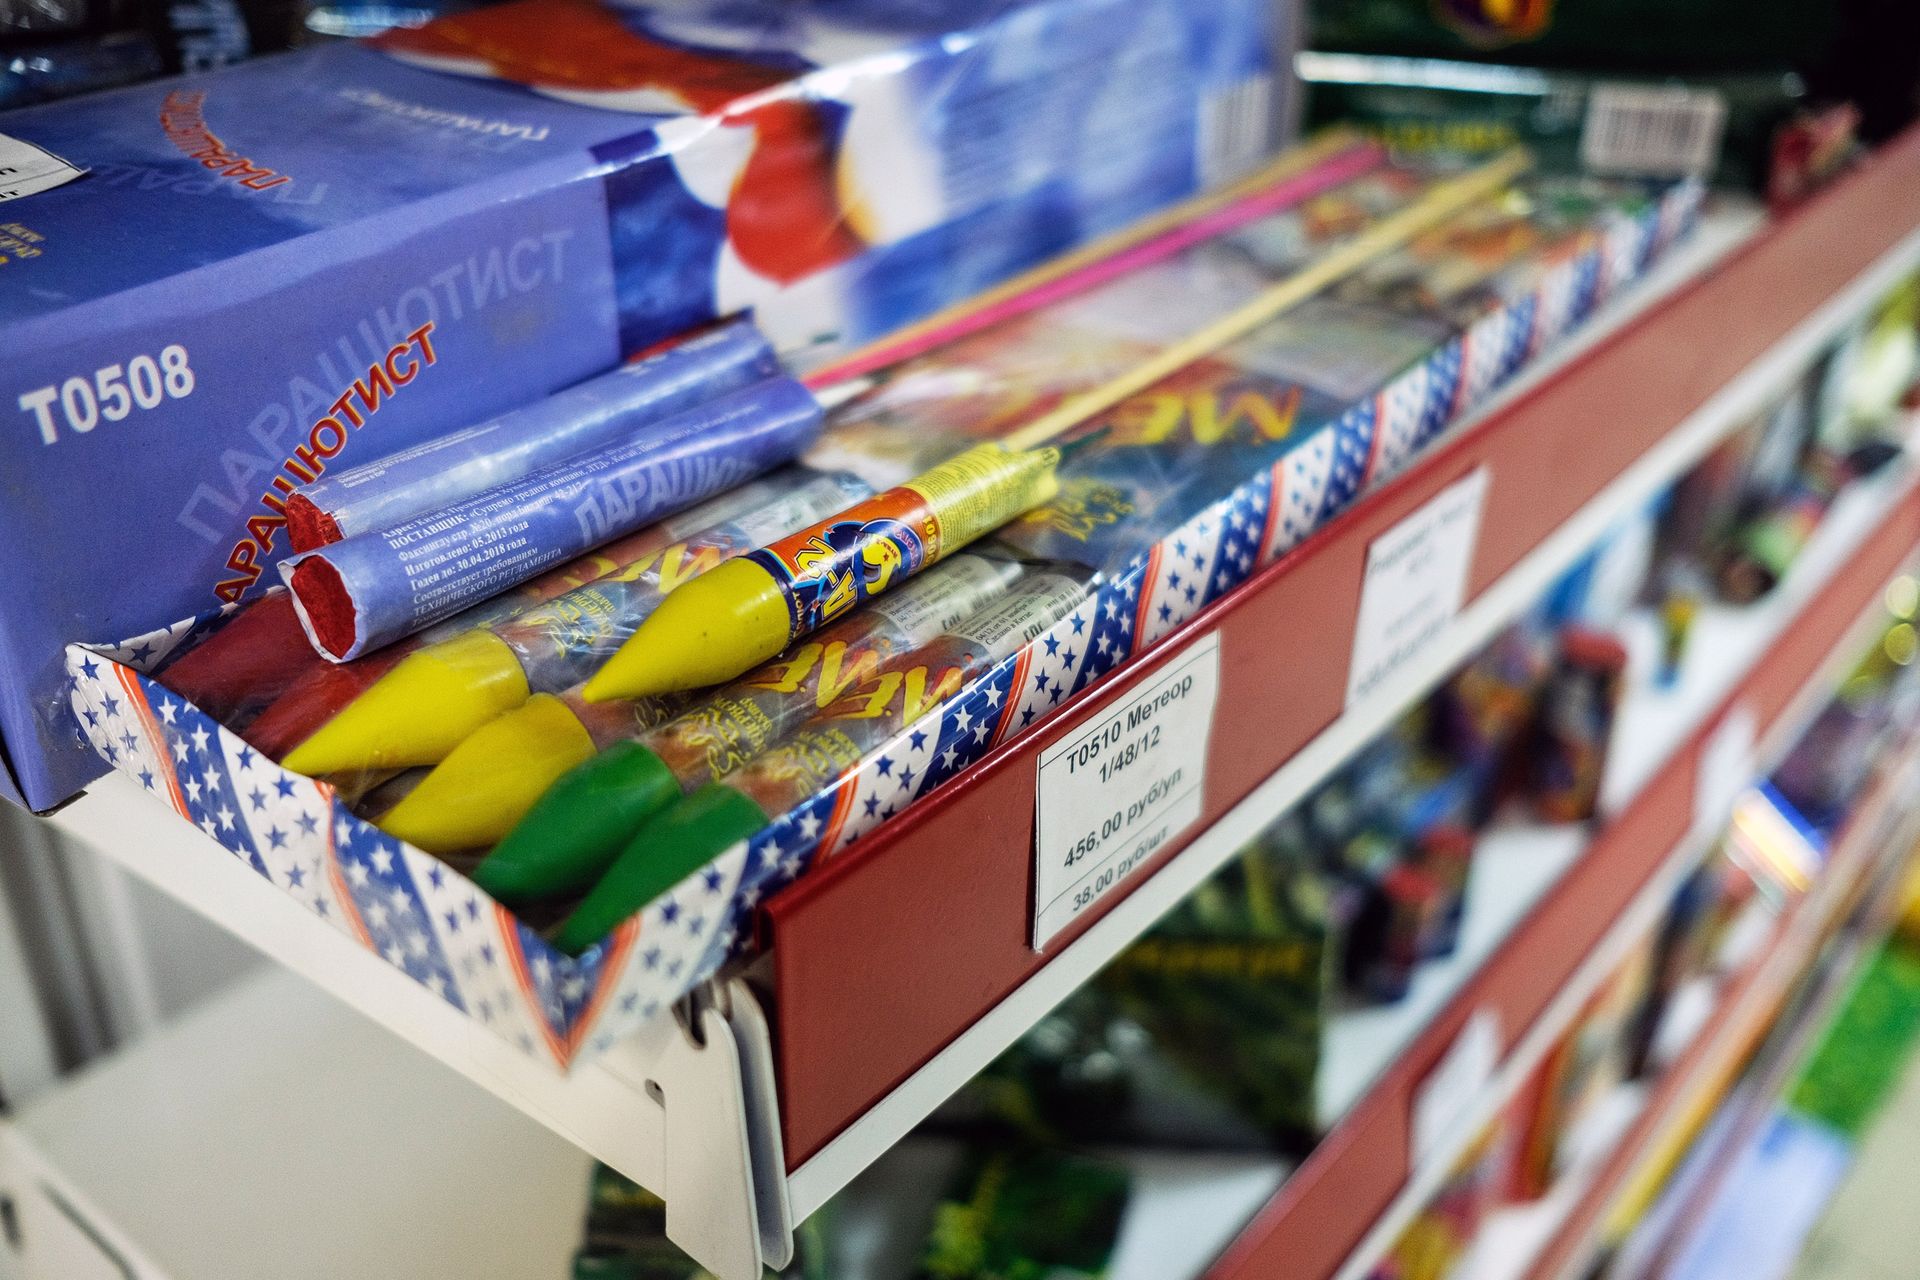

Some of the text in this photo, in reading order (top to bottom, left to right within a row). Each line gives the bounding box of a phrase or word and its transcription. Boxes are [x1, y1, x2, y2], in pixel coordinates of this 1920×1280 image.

[214, 320, 437, 604] АРАШЮТИСТ
[389, 514, 470, 549] ПОСТАВЩИК:
[405, 519, 529, 576] Изготовлено: 05.2013 года
[410, 536, 528, 591] Годен до: 30.04.2018 года
[1127, 674, 1193, 733] Метеор
[1098, 725, 1161, 784] 1/48/12
[1064, 767, 1183, 868] 456,00 руб/уп
[1073, 824, 1169, 912] 38,00 руб/шт
